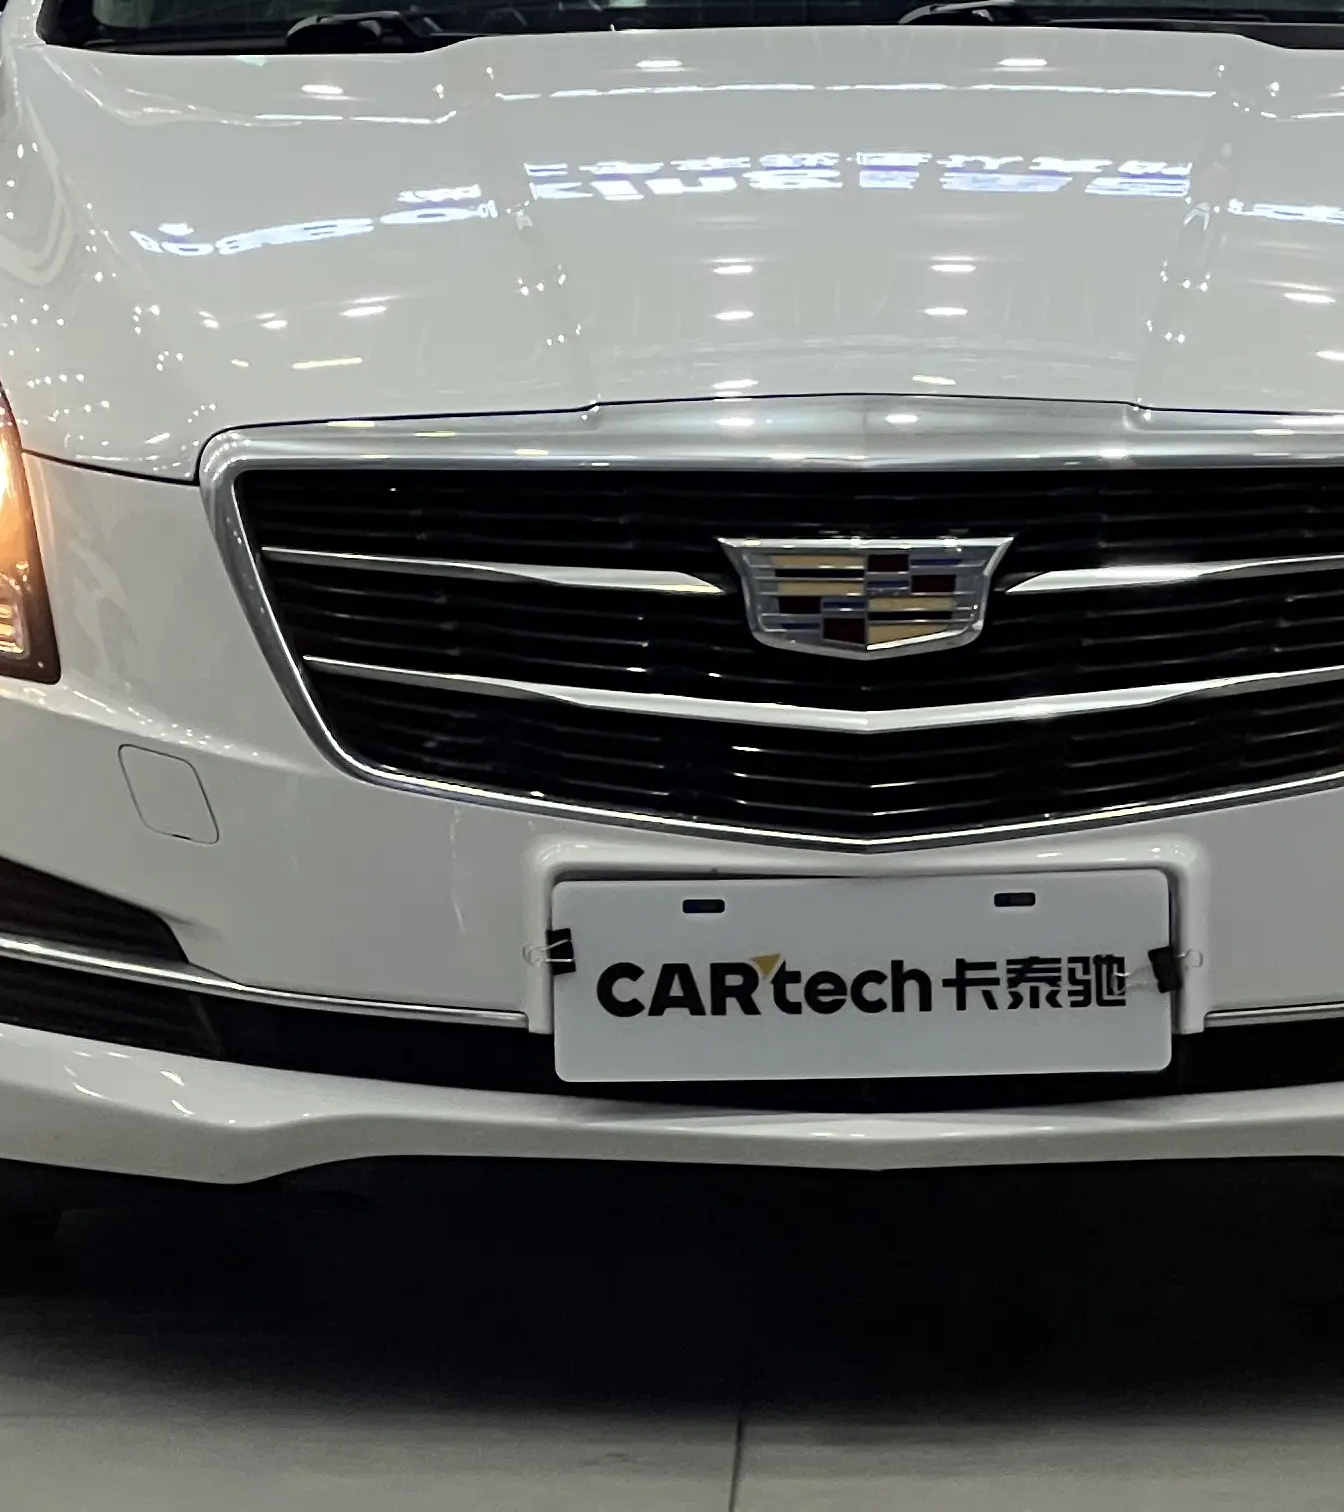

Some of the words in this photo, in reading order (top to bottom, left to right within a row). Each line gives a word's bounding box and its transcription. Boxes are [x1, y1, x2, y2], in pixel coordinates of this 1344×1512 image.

[596, 954, 933, 1018] CARtech
[941, 955, 1127, 1011] 卡泰驰
